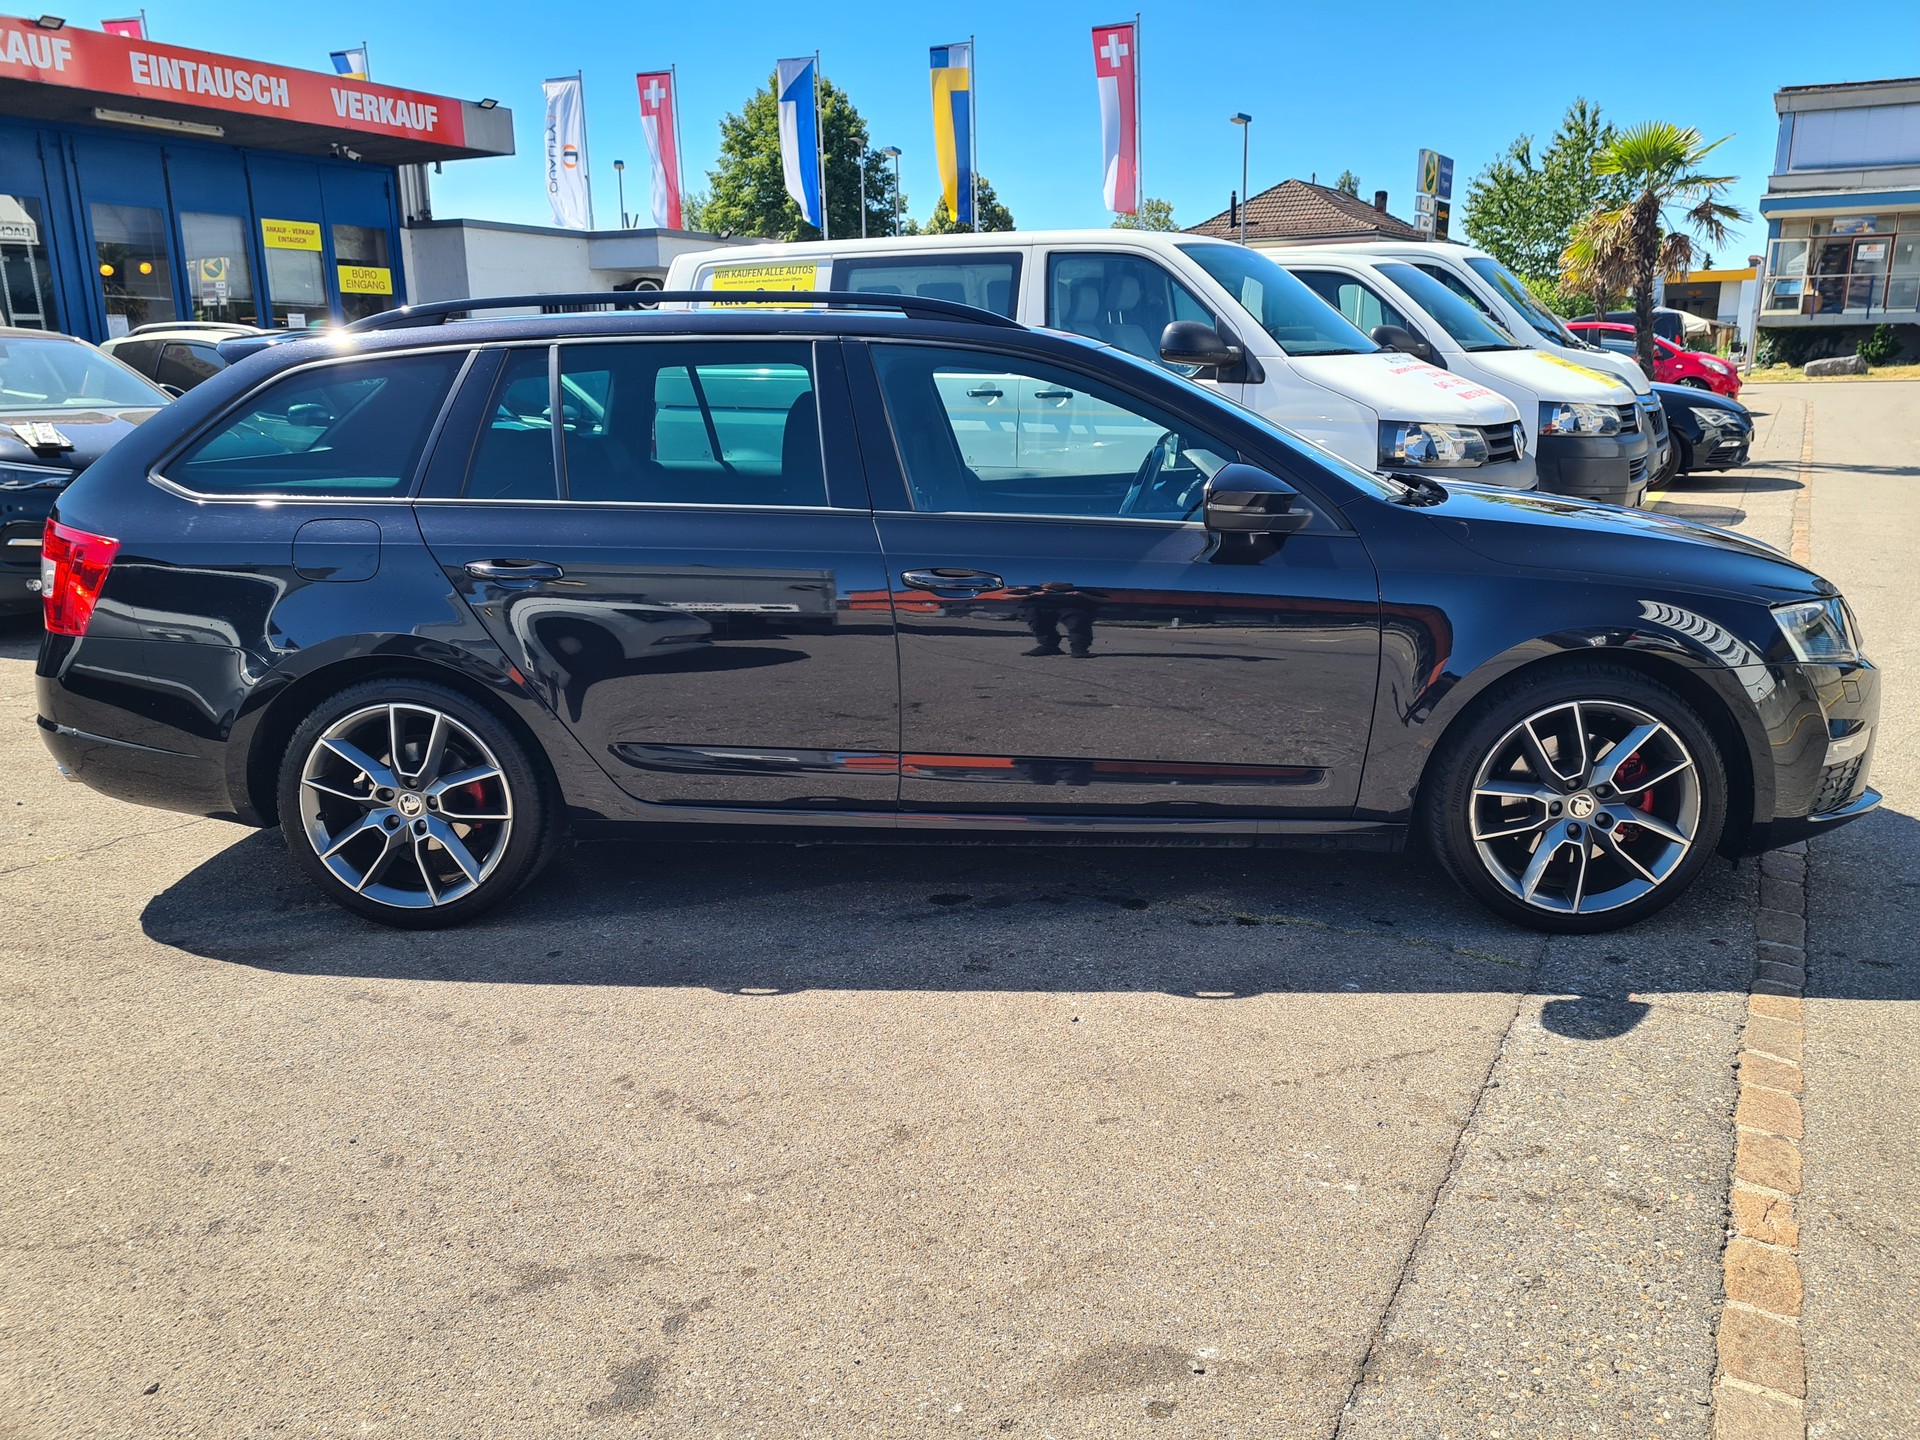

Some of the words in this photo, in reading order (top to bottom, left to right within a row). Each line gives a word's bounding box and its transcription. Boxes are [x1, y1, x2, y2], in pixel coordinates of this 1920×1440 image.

[129, 51, 290, 108] EINTAUSCH
[330, 88, 438, 131] VERKAUF
[266, 226, 287, 234] ANKAUF
[292, 228, 315, 236] VERKAUF
[278, 236, 307, 244] EINTAUSCH
[352, 268, 377, 279] BÜRO
[715, 270, 729, 279] WIR
[731, 268, 763, 278] KAUFEN
[765, 267, 784, 276] ALLE
[786, 265, 814, 275] AUTOS
[346, 279, 386, 290] EINGANG
